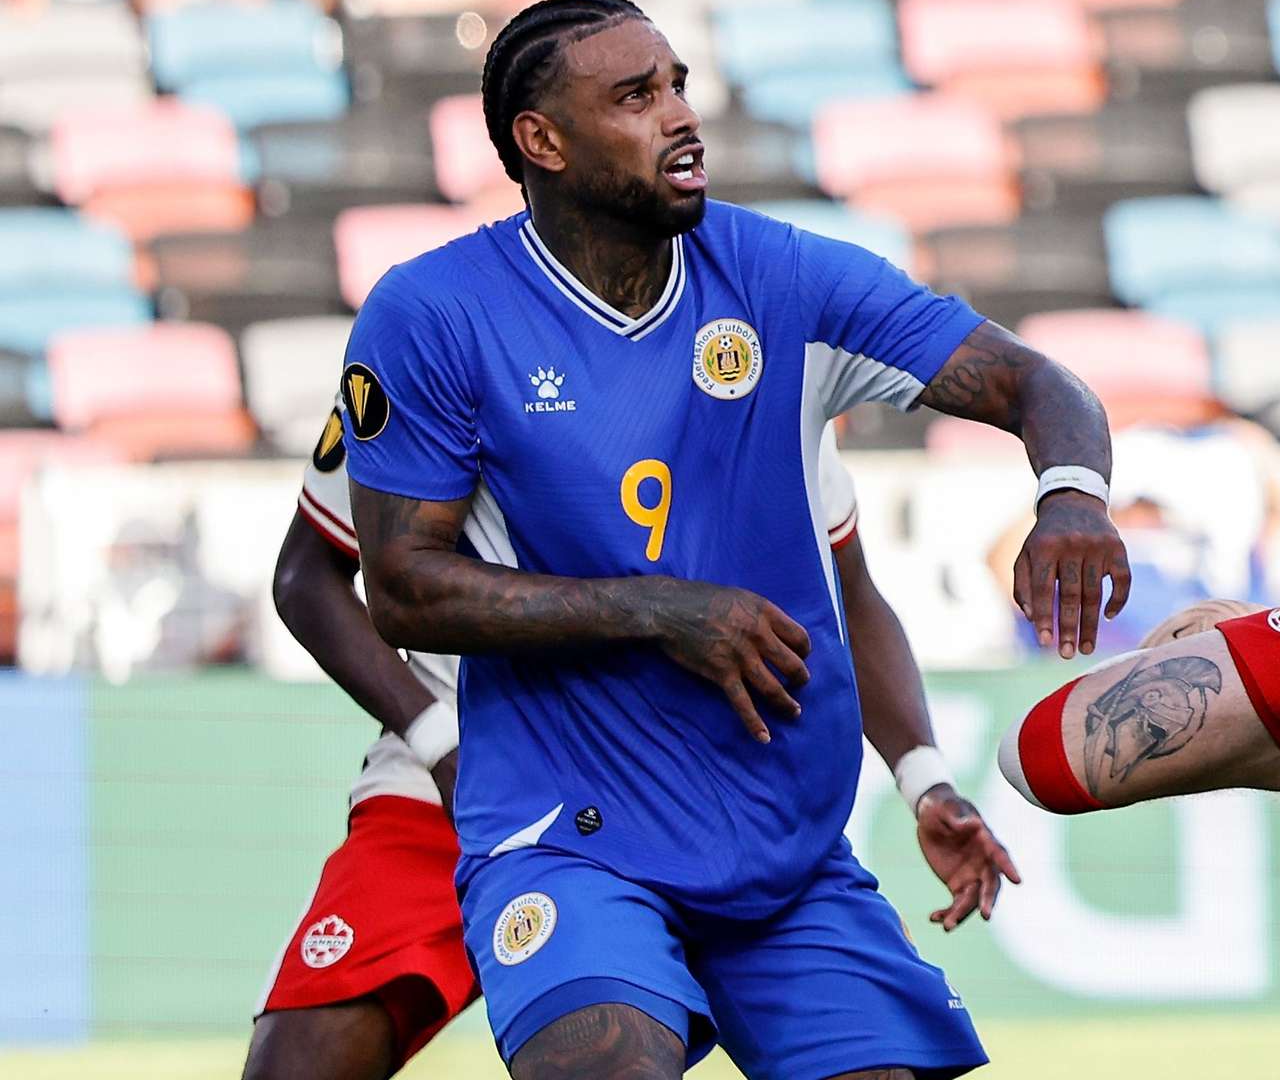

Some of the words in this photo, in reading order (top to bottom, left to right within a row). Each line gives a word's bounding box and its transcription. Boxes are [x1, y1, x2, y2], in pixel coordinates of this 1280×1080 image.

[694, 328, 716, 391] Federashon
[525, 400, 576, 413] KELME
[620, 458, 672, 562] 9
